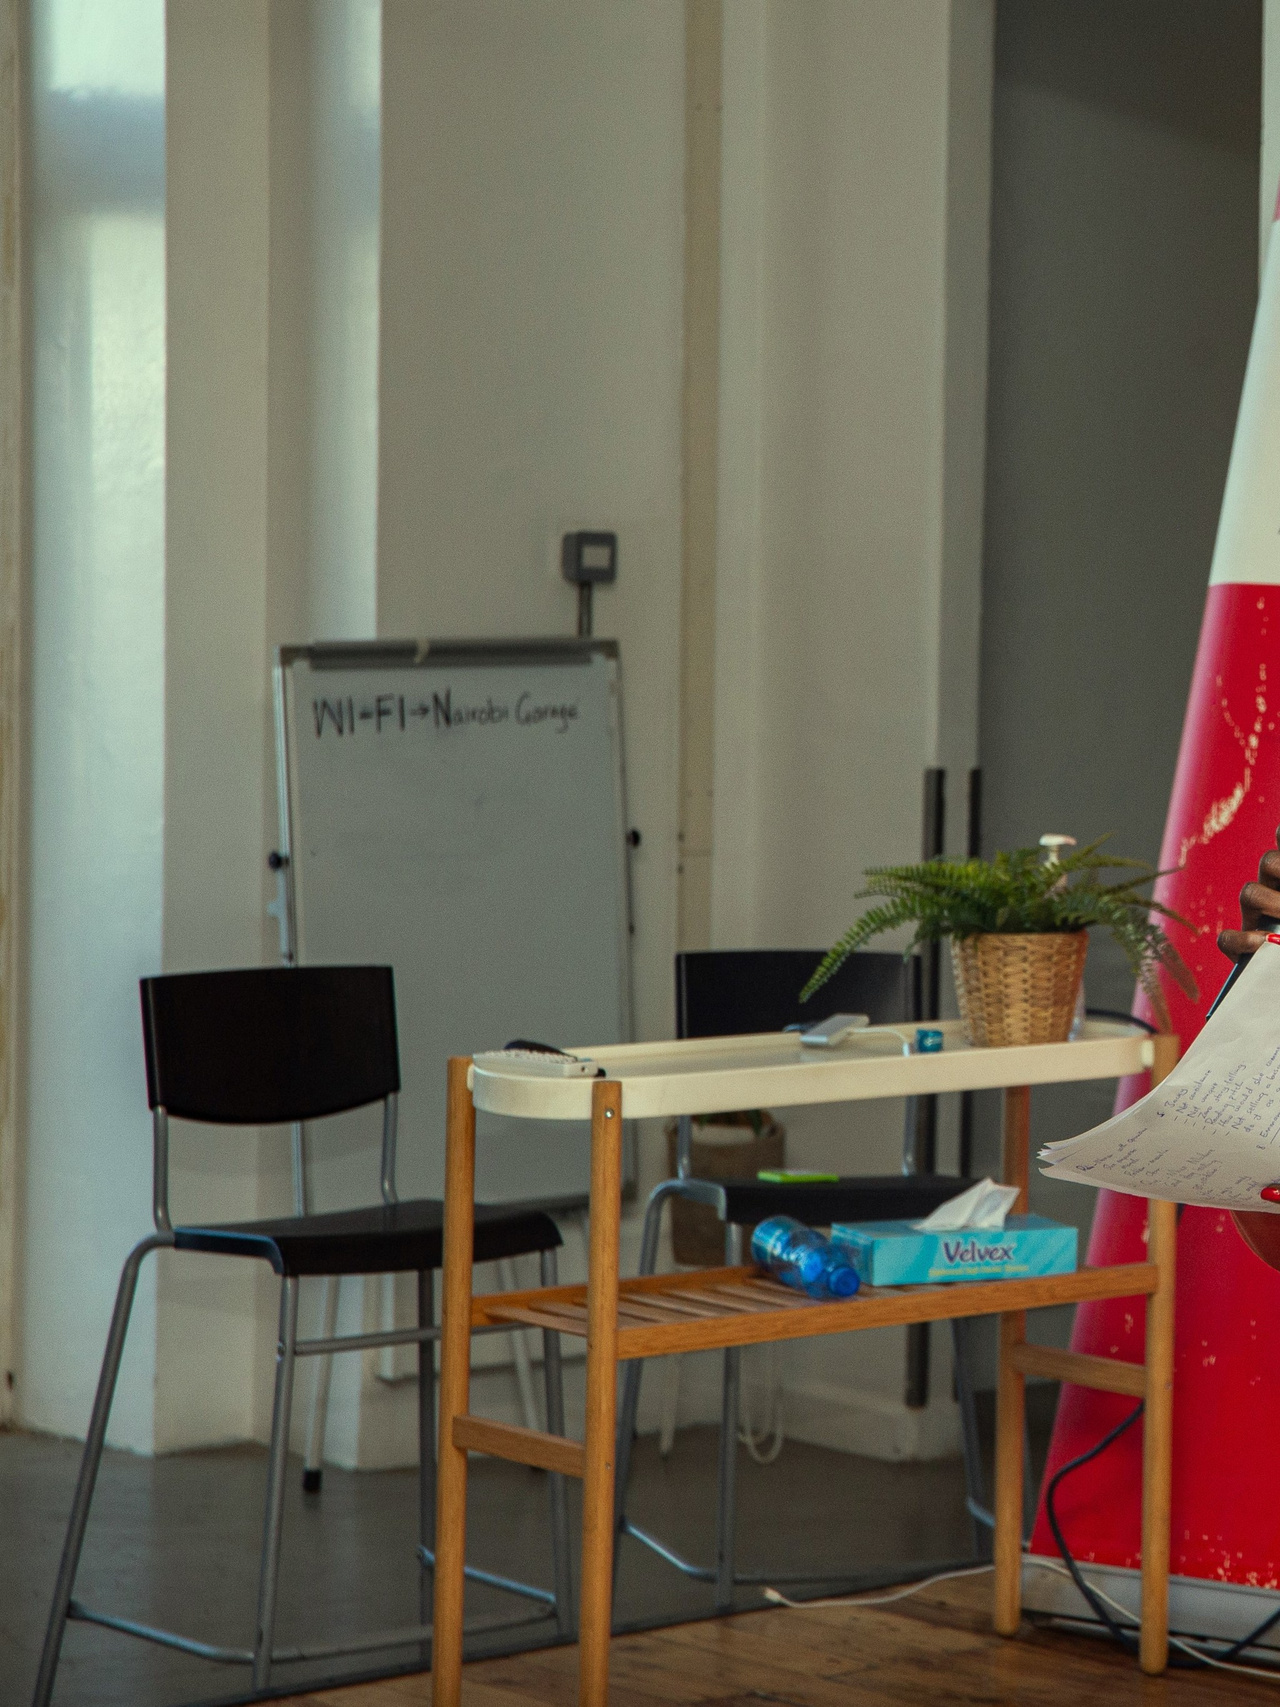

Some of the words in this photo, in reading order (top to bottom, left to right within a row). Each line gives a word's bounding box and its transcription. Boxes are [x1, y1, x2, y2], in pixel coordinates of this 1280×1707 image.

[431, 688, 509, 729] Nairobi
[514, 690, 579, 734] Garage
[942, 1239, 1013, 1264] Velvex
